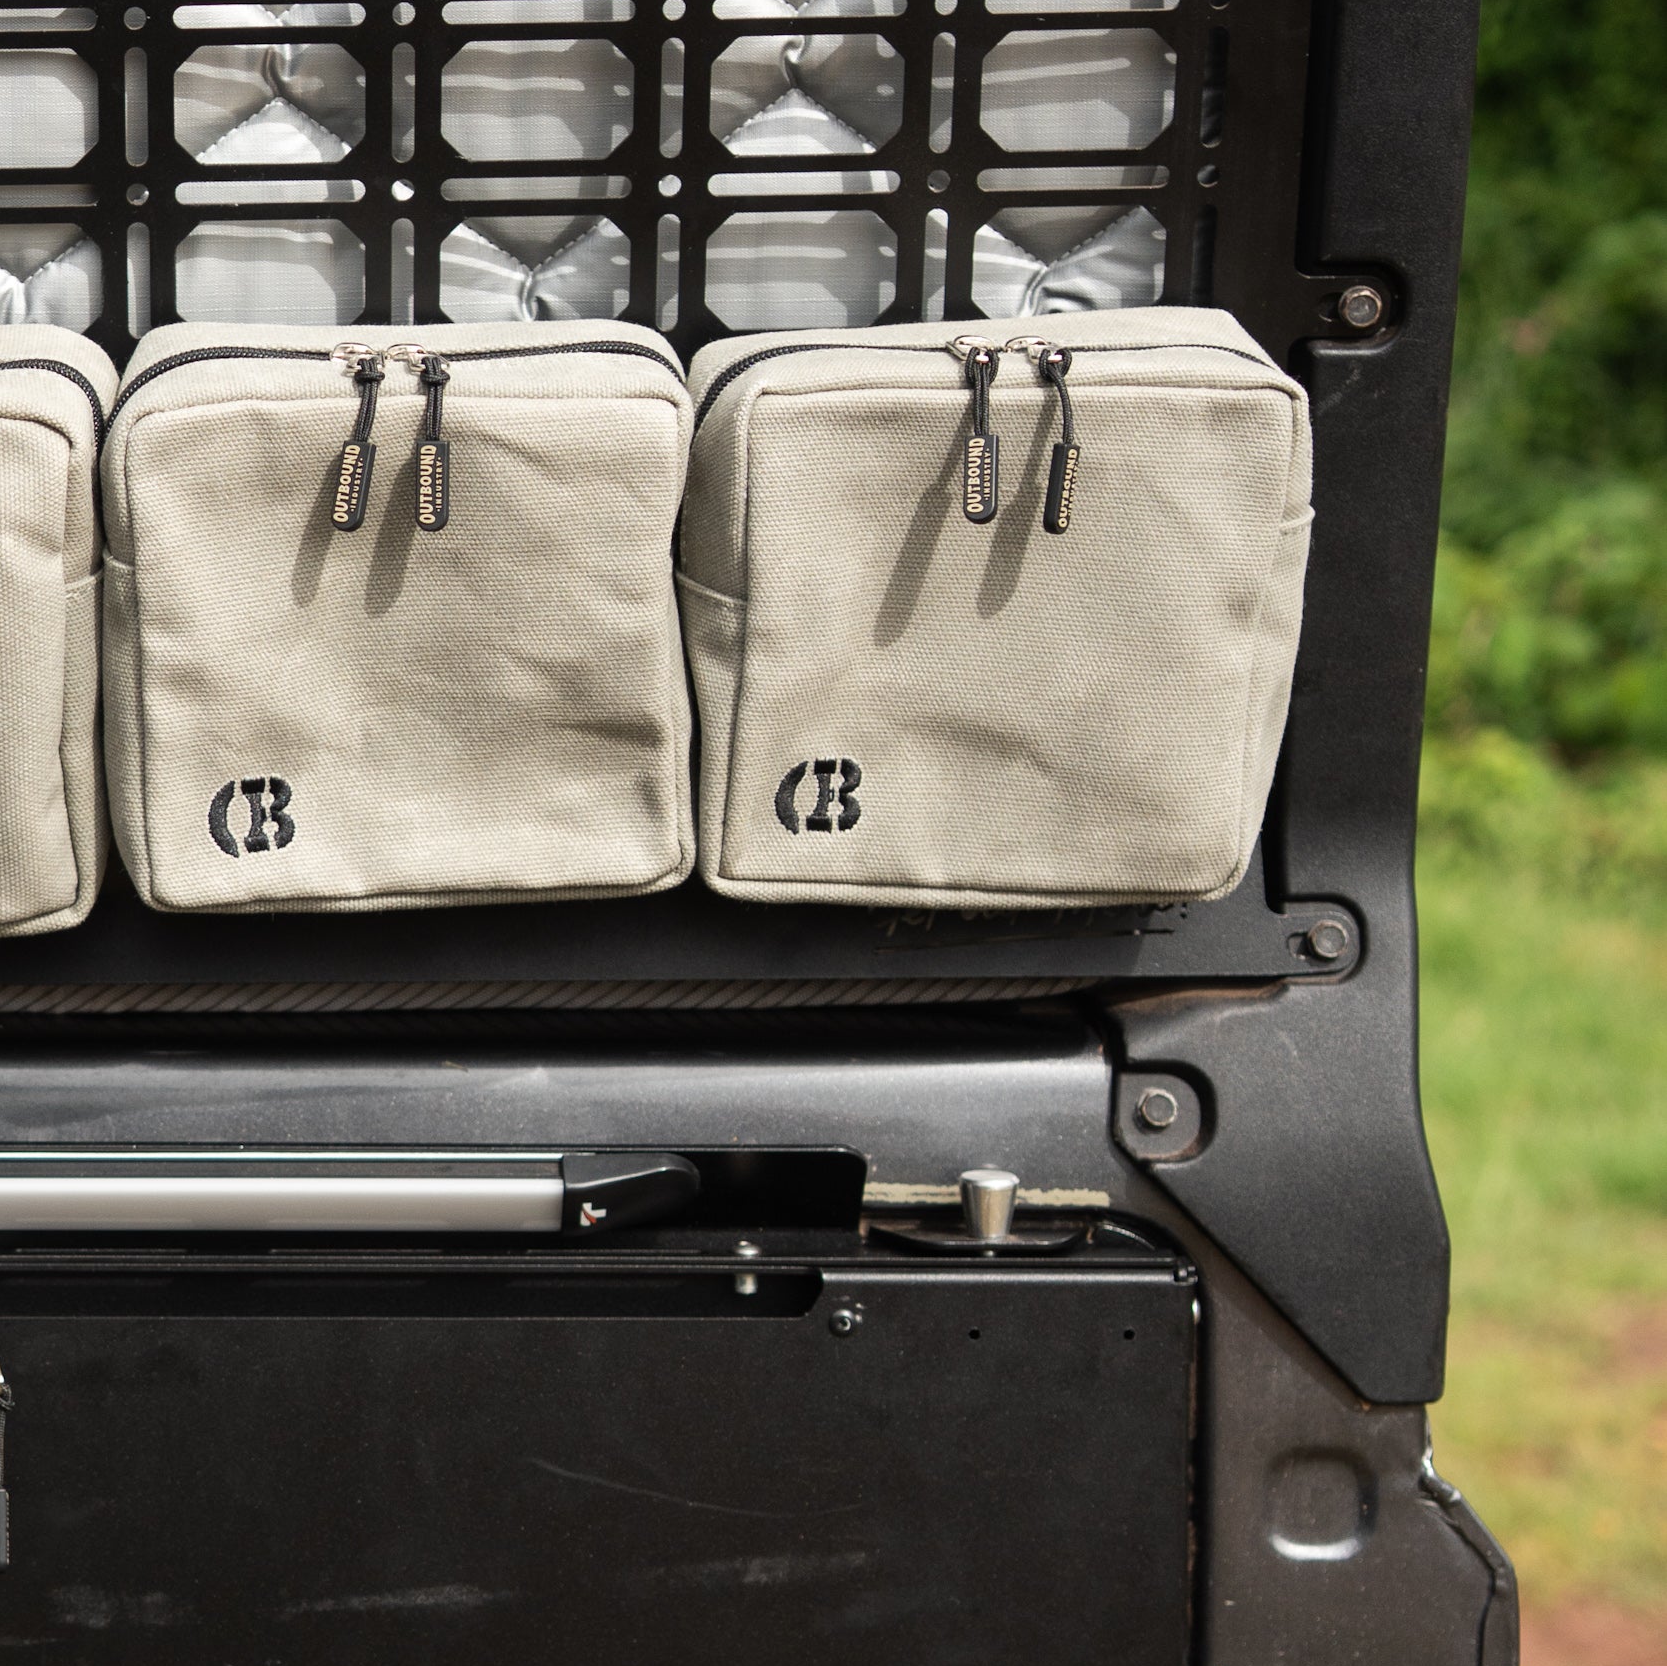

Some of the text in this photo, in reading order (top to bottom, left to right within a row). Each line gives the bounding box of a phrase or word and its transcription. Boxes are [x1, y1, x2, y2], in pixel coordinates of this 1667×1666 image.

[333, 445, 361, 523] OUTBOUND
[419, 445, 437, 524] OUTBOUND
[967, 437, 986, 513] OUTBOUND
[1057, 448, 1078, 528] OUTBOUND
